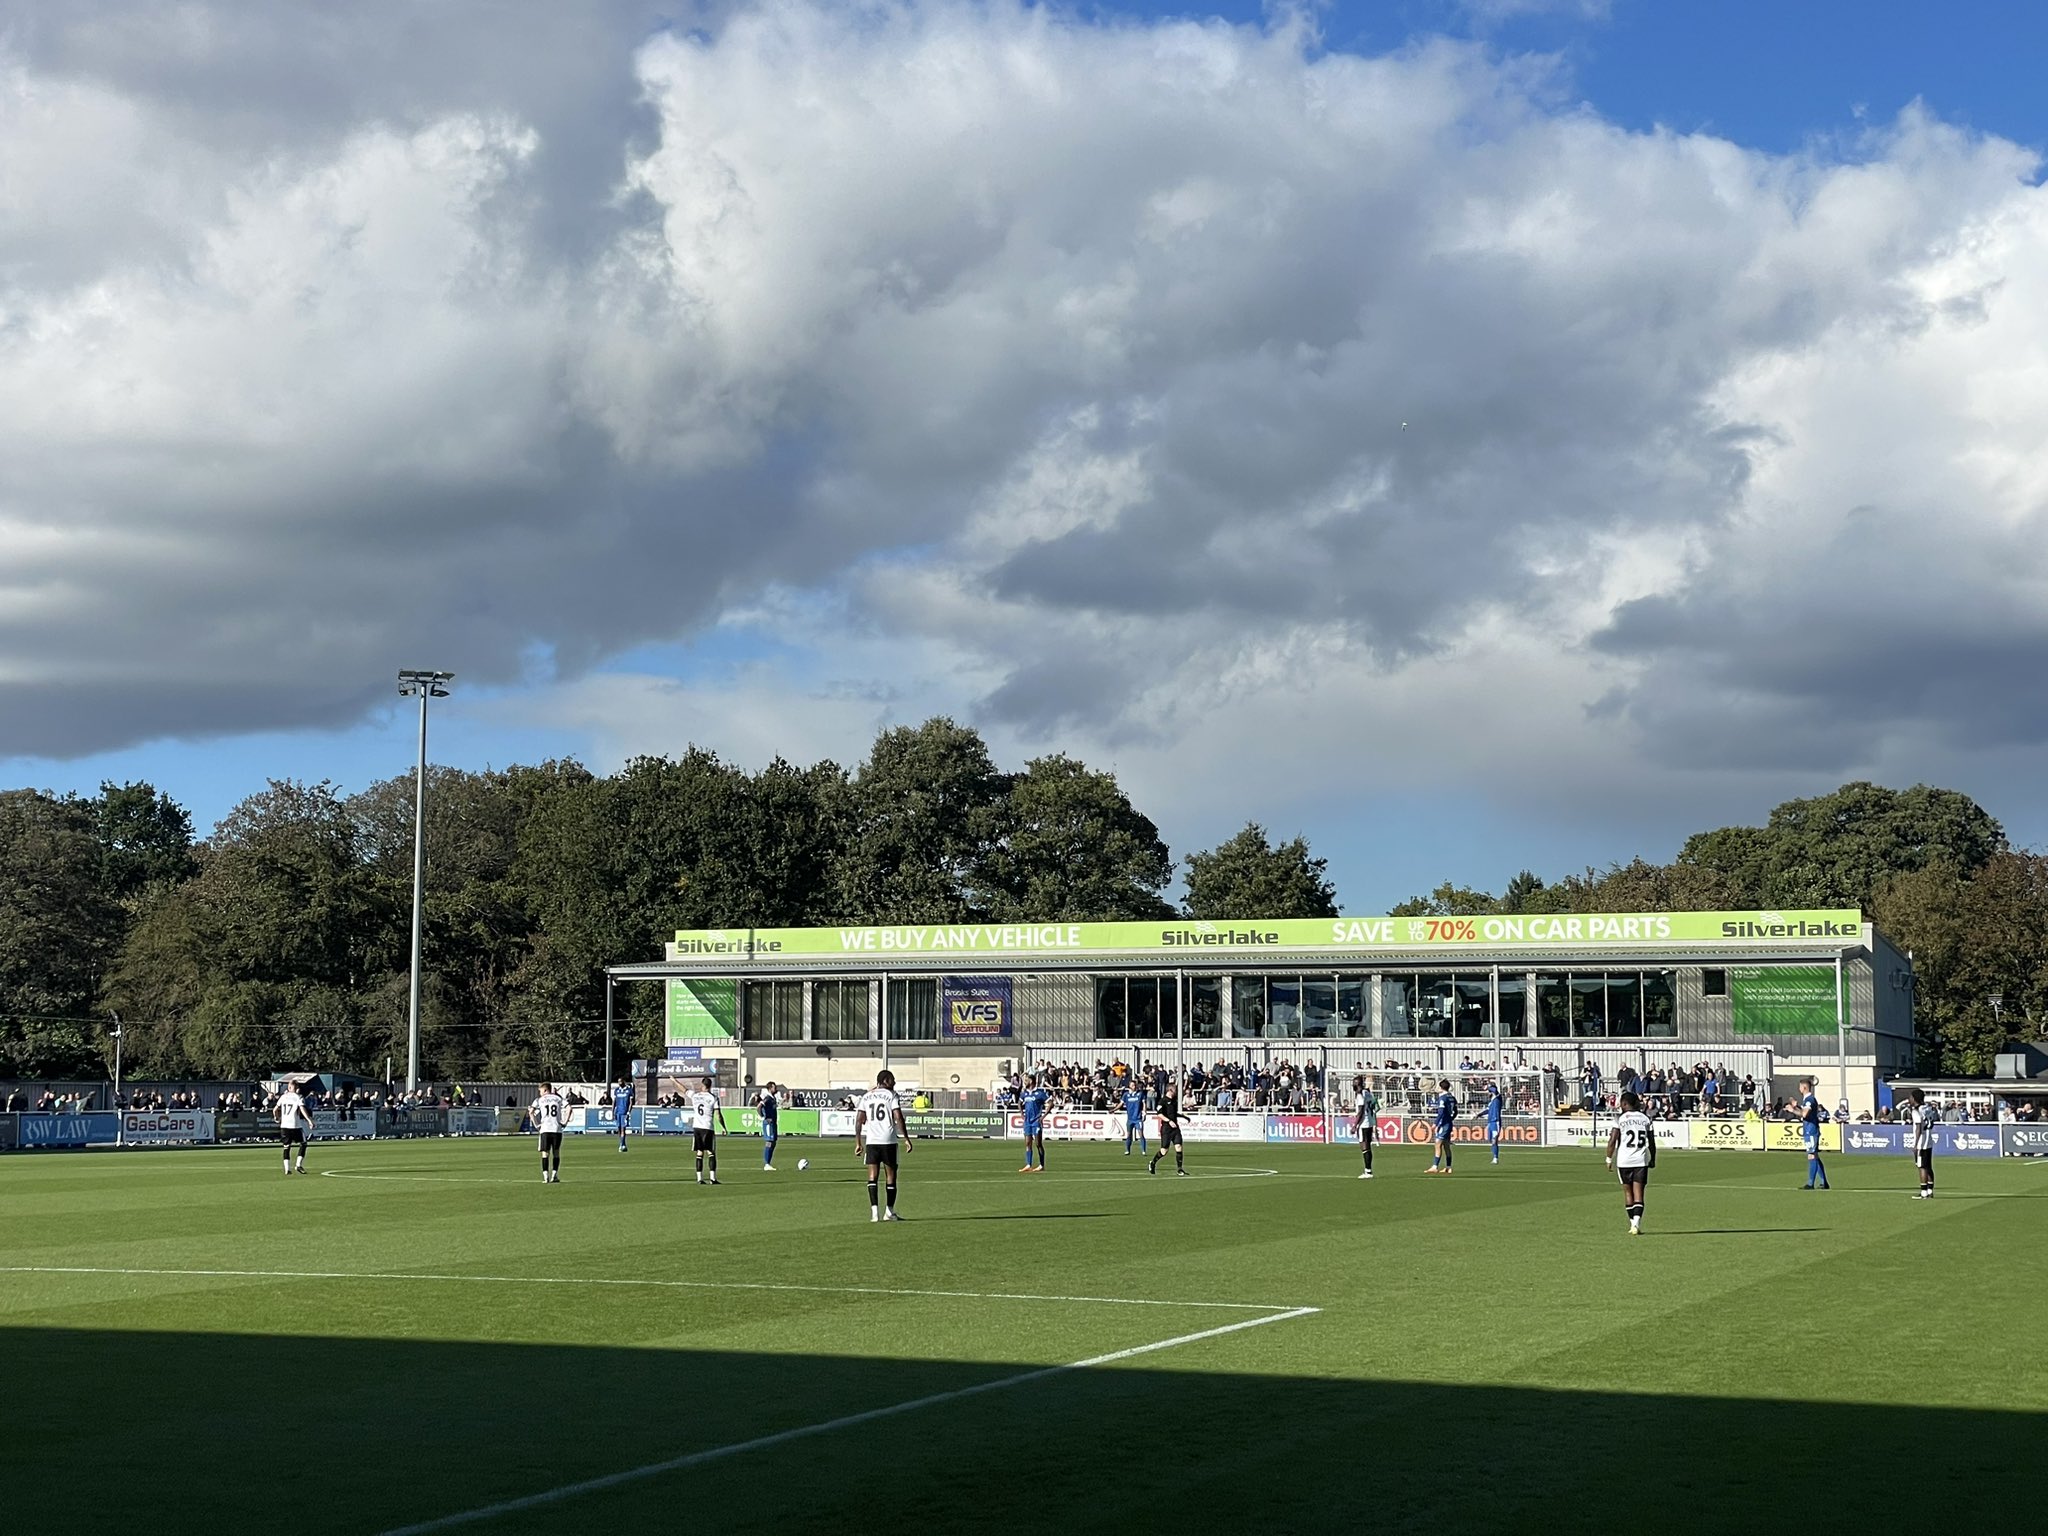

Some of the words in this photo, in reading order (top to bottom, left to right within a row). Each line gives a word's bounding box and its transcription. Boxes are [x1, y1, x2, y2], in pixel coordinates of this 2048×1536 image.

[1332, 920, 1395, 943] SAVE
[1407, 921, 1424, 932] UP
[1426, 920, 1476, 941] 70%
[1483, 919, 1527, 940] ON
[1528, 918, 1583, 940] CAR
[1589, 917, 1671, 939] PARTS
[1722, 920, 1857, 938] Silverlake
[839, 930, 876, 950] WE
[880, 928, 928, 949] BUY
[931, 927, 981, 948] ANY
[985, 926, 1081, 947] VEHICLE
[1161, 929, 1279, 945] Silverlake
[1408, 932, 1425, 941] TO
[677, 938, 782, 953] Silverlake
[944, 988, 969, 996] Brooks
[970, 988, 990, 996] Suite
[957, 1005, 998, 1021] VFS
[954, 1025, 999, 1033] SCATTOLINI
[657, 1065, 673, 1073] Food
[675, 1065, 682, 1073] &
[682, 1065, 705, 1073] Drinks
[282, 1103, 294, 1116] 17
[544, 1104, 558, 1118] 18
[697, 1103, 705, 1117] 6
[803, 1099, 833, 1107] ELLOR
[868, 1102, 886, 1122] 16
[56, 1120, 92, 1139] LAW
[126, 1115, 195, 1132] GasCare
[955, 1117, 989, 1126] SUPPLIES
[989, 1117, 1003, 1126] LTD
[1010, 1114, 1105, 1131] GsCare
[1201, 1120, 1228, 1129] Services
[1228, 1120, 1240, 1129] Ltd
[1267, 1121, 1315, 1138] utilita
[1708, 1124, 1746, 1136] SOS
[1625, 1129, 1646, 1149] 25
[1700, 1138, 1728, 1146] storage
[1740, 1138, 1753, 1146] site
